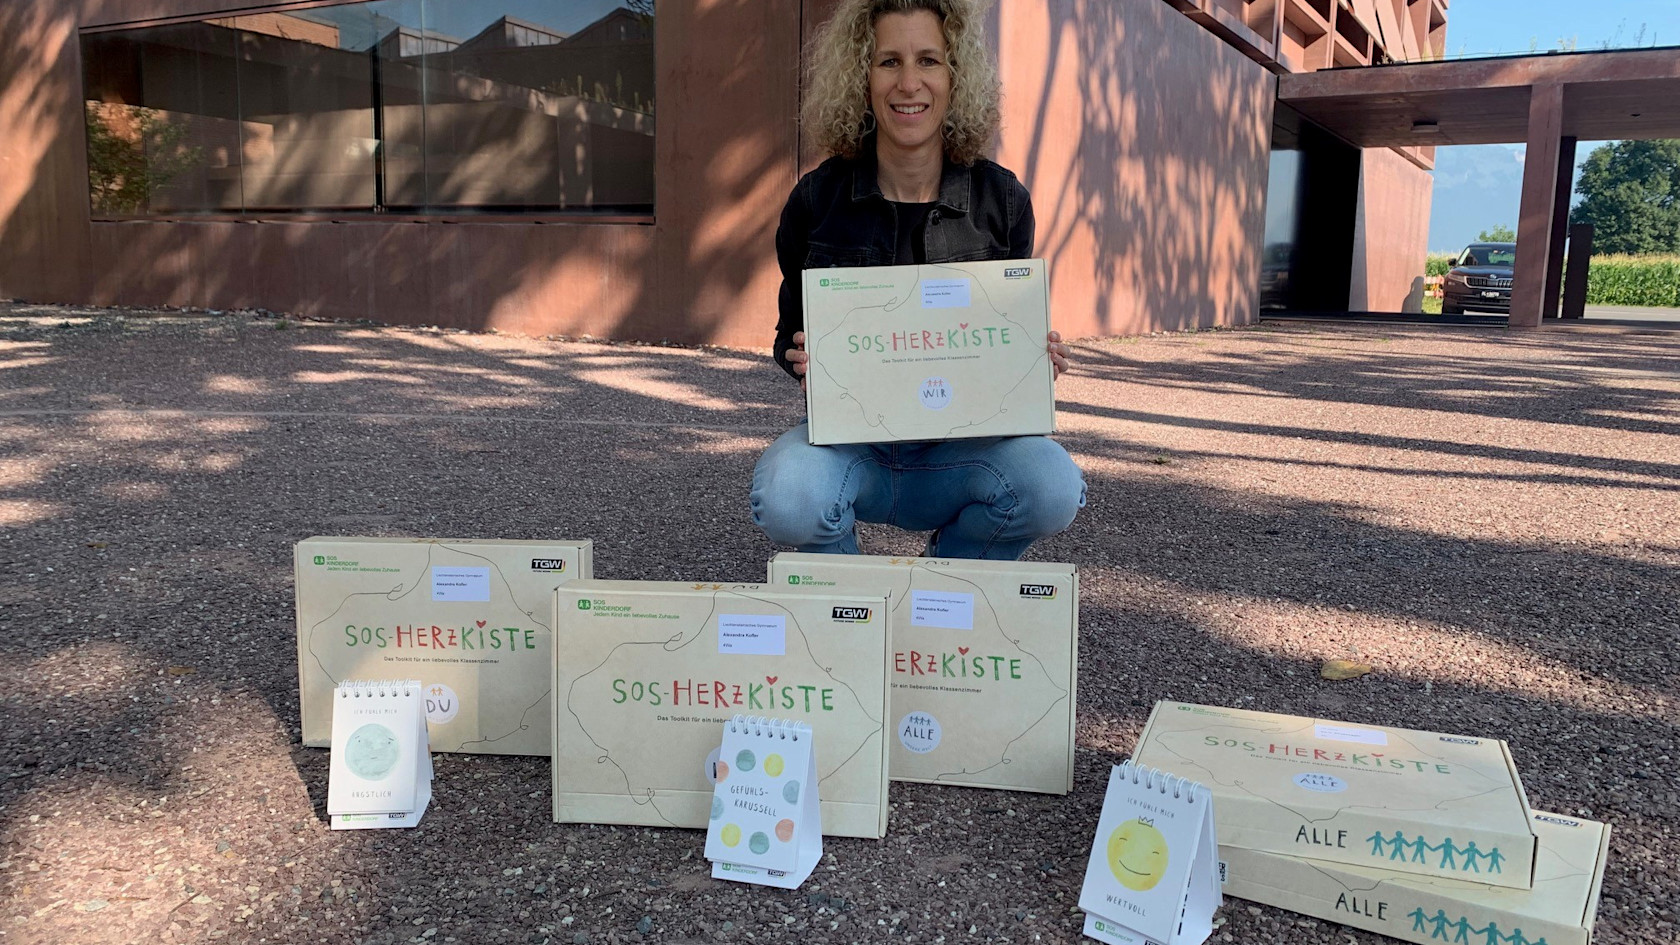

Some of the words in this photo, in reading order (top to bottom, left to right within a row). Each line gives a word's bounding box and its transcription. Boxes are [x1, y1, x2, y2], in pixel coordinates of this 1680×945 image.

[923, 389, 947, 399] WIR
[533, 560, 561, 568] TGW
[1021, 586, 1052, 595] TGW
[834, 608, 867, 618] TGW
[894, 649, 1022, 681] ERZKISTE
[909, 683, 938, 691] liebevolles
[426, 699, 450, 713] DU
[904, 725, 934, 740] ALLE
[1300, 778, 1338, 787] ALLE
[734, 798, 777, 817] KARUSSELL
[1295, 824, 1348, 849] ALLE
[1106, 893, 1147, 917] WERTVOLL
[1335, 892, 1388, 921] ALLE
